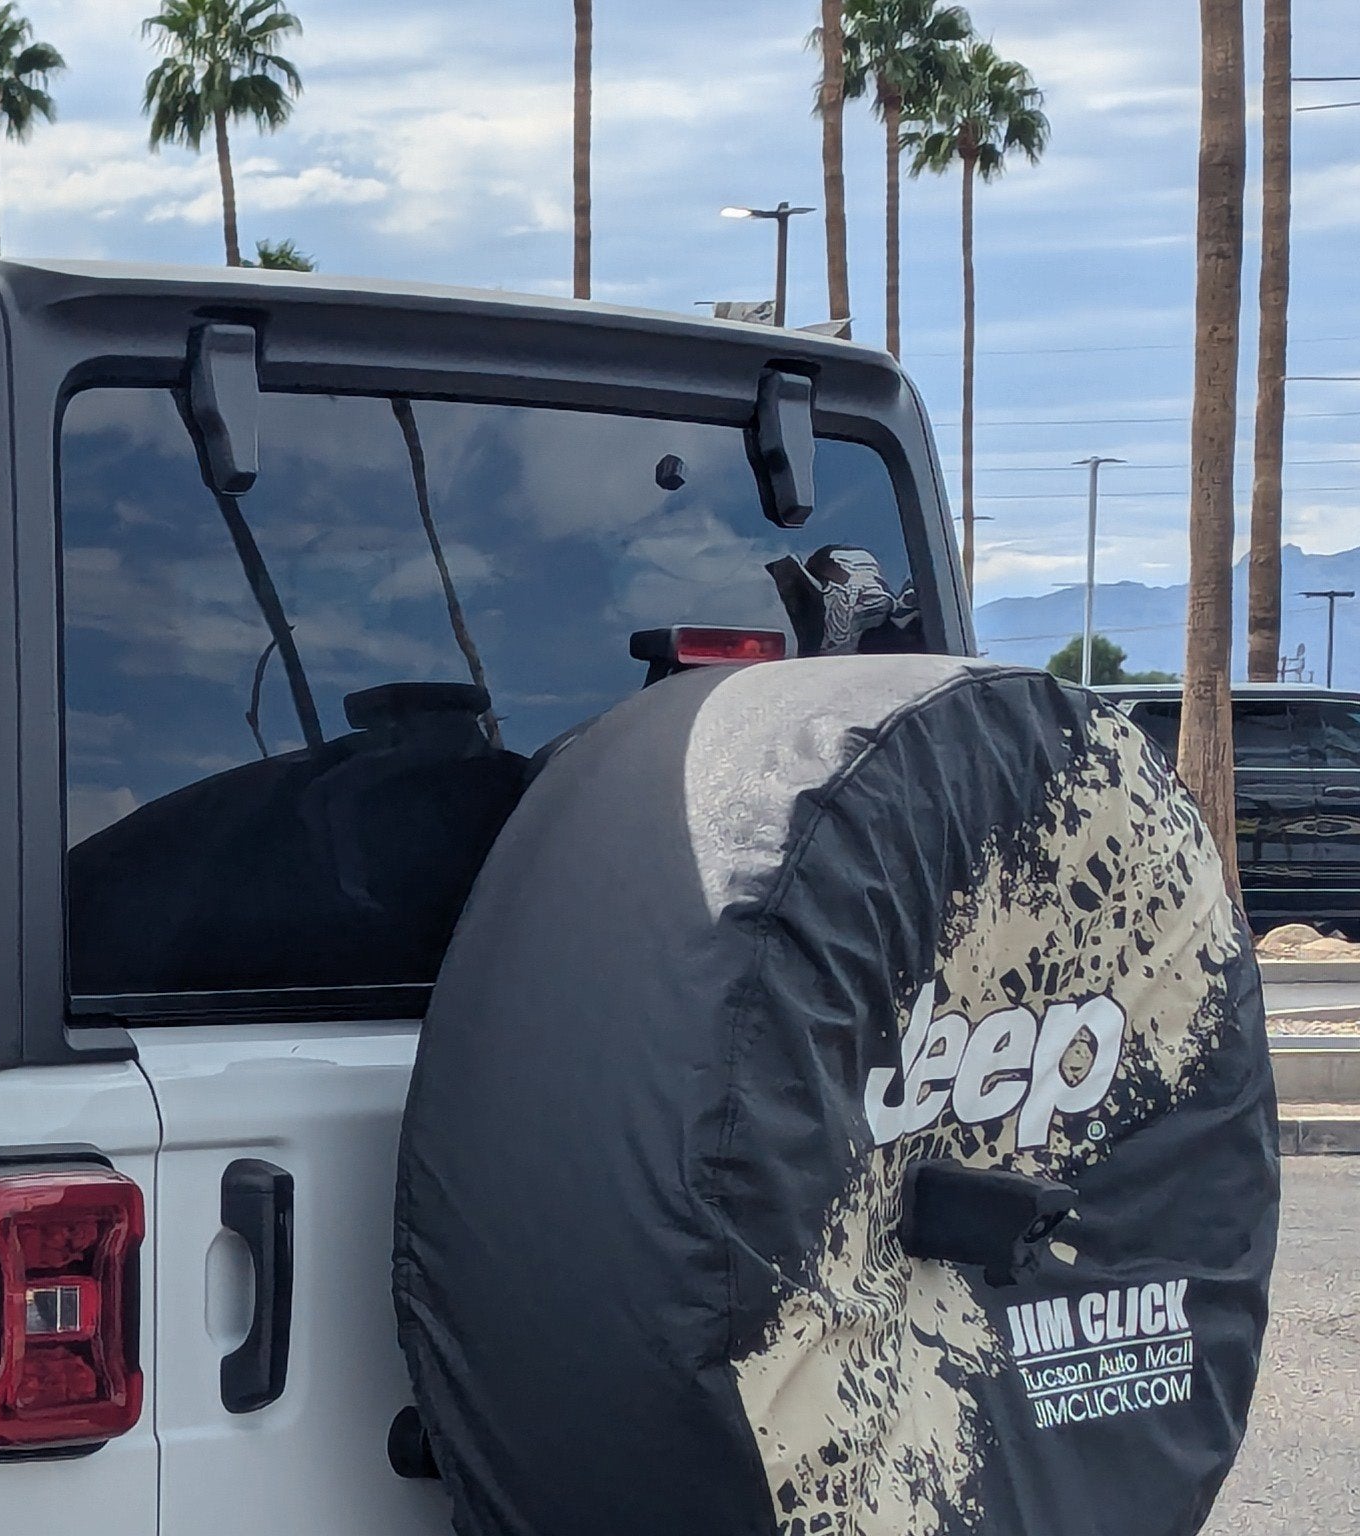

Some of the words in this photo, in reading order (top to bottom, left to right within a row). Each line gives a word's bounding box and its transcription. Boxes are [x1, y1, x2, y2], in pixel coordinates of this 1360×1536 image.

[864, 979, 1126, 1148] Jeep
[1007, 1297, 1075, 1357] JIM
[1079, 1279, 1189, 1343] CLICK
[1019, 1361, 1092, 1392] Tucson
[1099, 1350, 1137, 1379] Auto
[1145, 1339, 1193, 1368] Mall
[1034, 1373, 1192, 1429] JIMCLICK.COM
